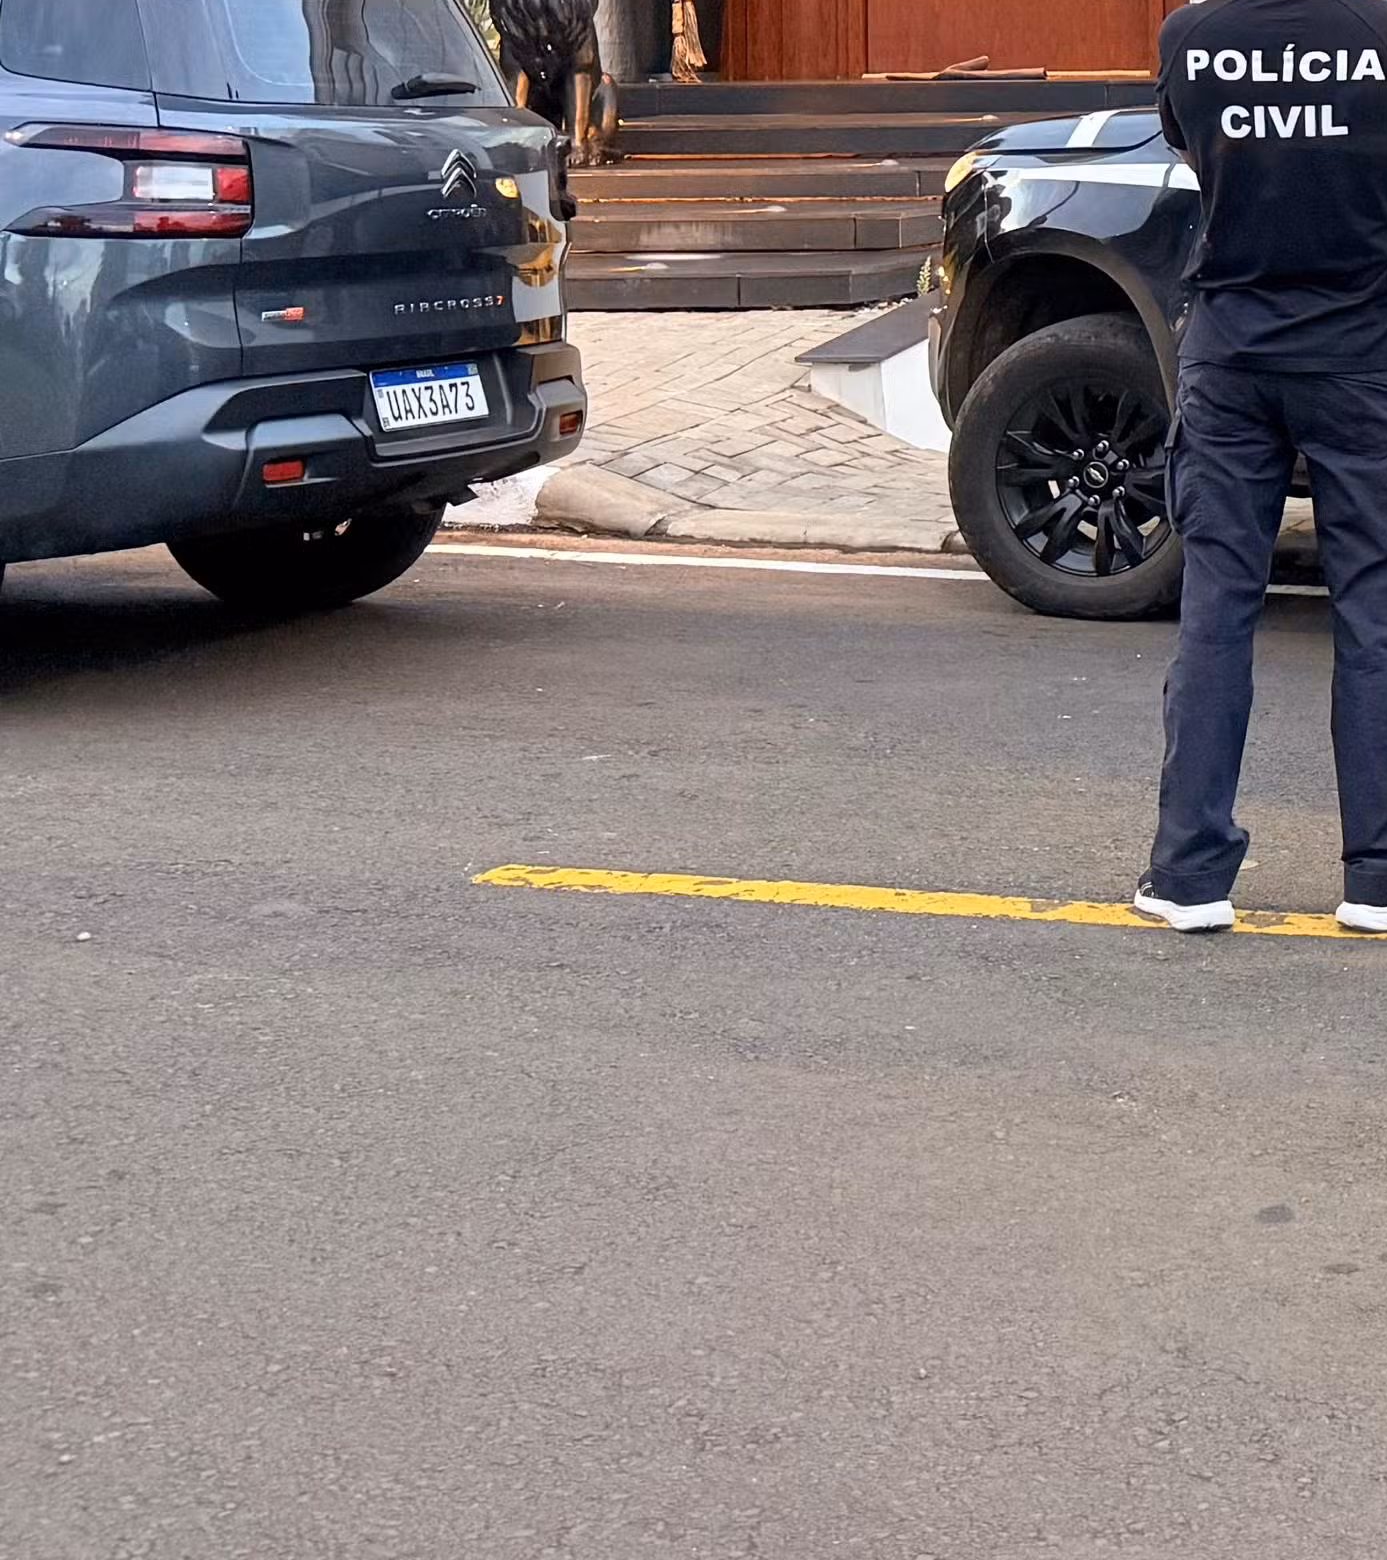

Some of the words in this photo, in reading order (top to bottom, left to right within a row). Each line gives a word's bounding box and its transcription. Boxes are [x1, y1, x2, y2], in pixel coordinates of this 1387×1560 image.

[1186, 43, 1386, 83] POLÍCIA
[1220, 104, 1349, 139] CIVIL
[386, 381, 476, 423] UAX3A73
